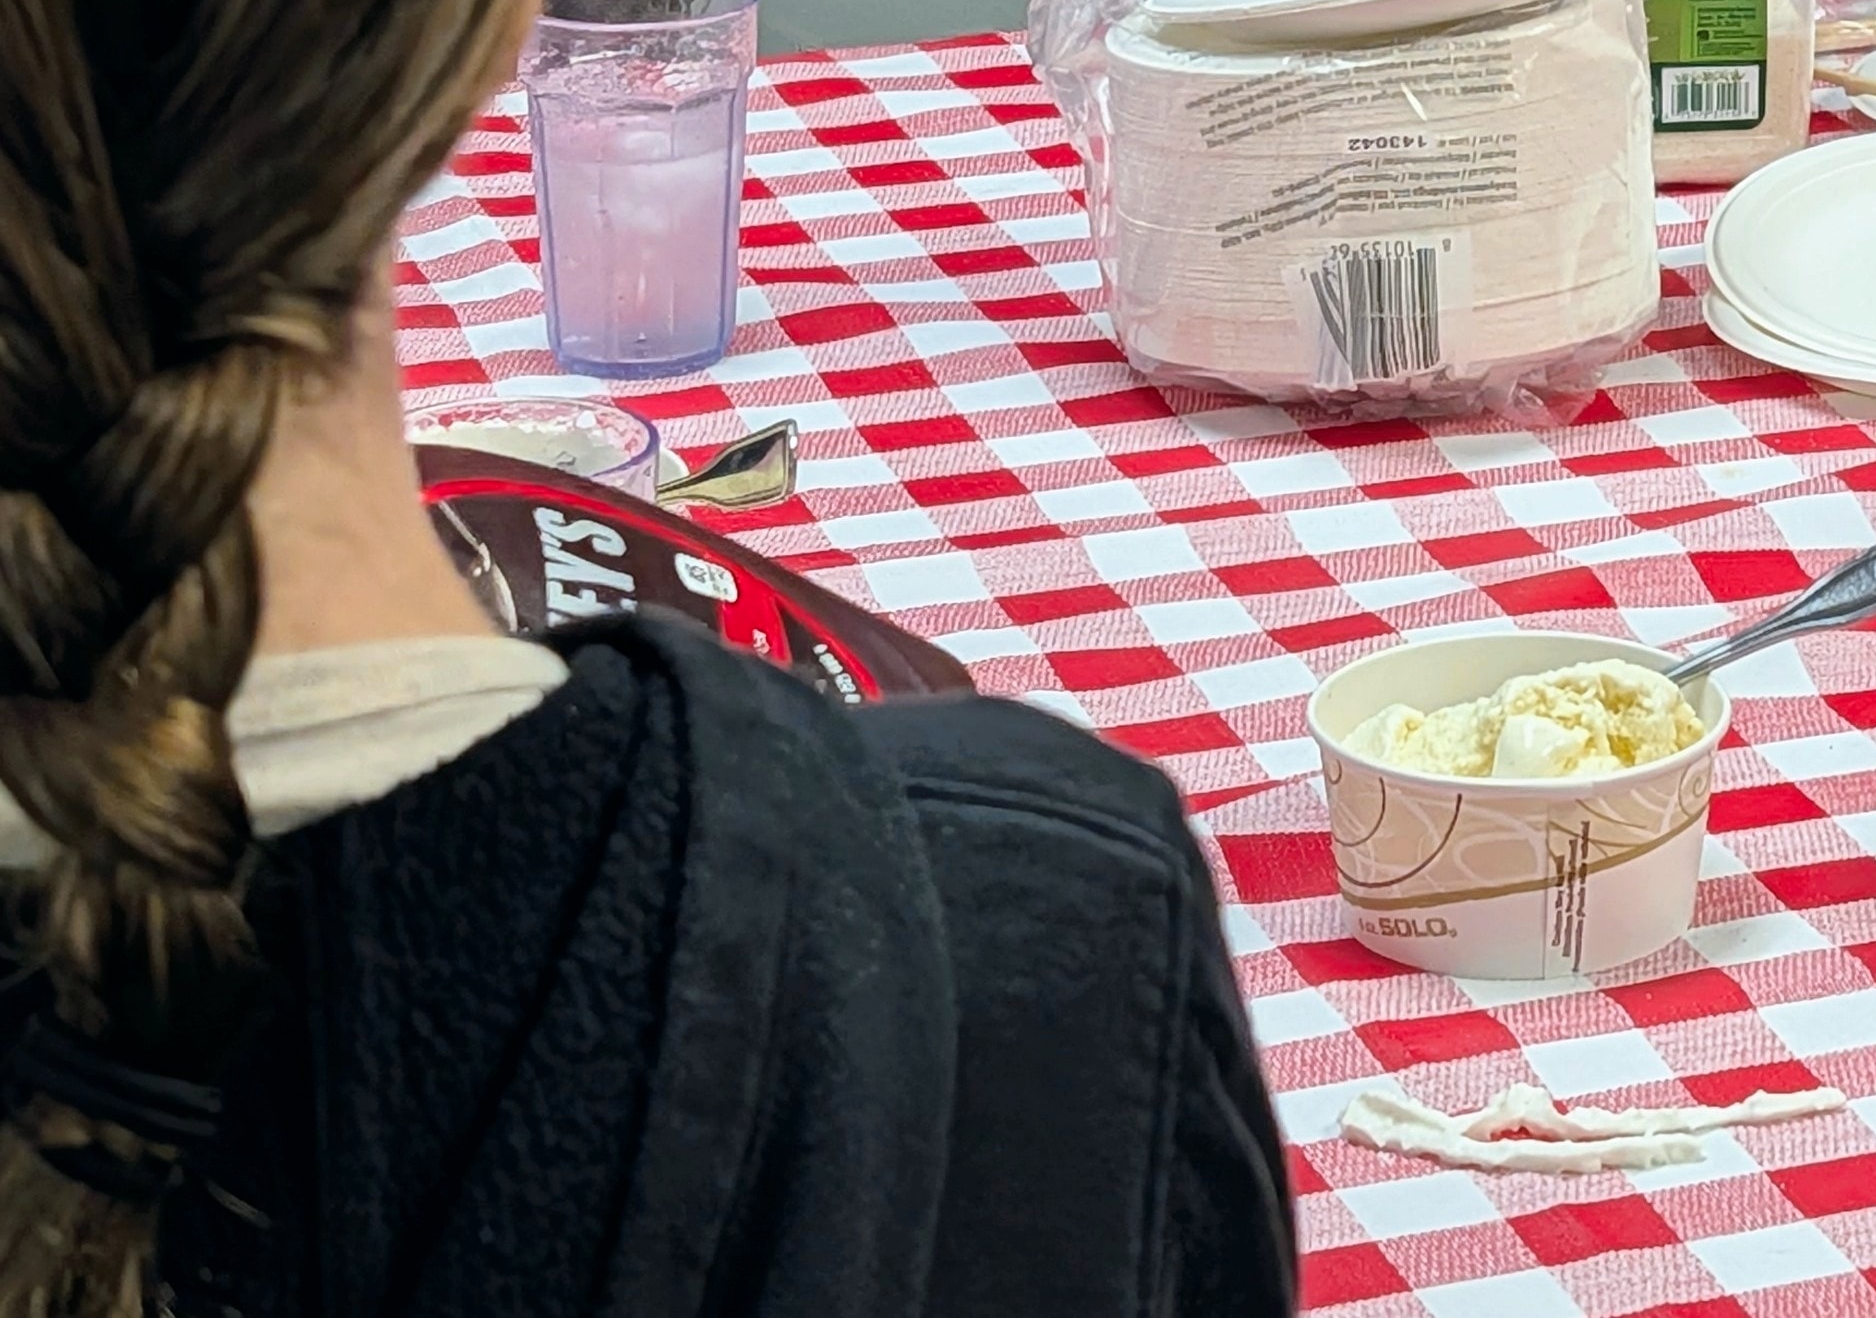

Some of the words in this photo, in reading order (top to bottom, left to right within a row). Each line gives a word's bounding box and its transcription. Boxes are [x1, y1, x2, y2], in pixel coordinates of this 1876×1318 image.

[1348, 135, 1427, 151] 143042
[534, 507, 636, 627] EY'S
[1378, 917, 1449, 938] SOLO
